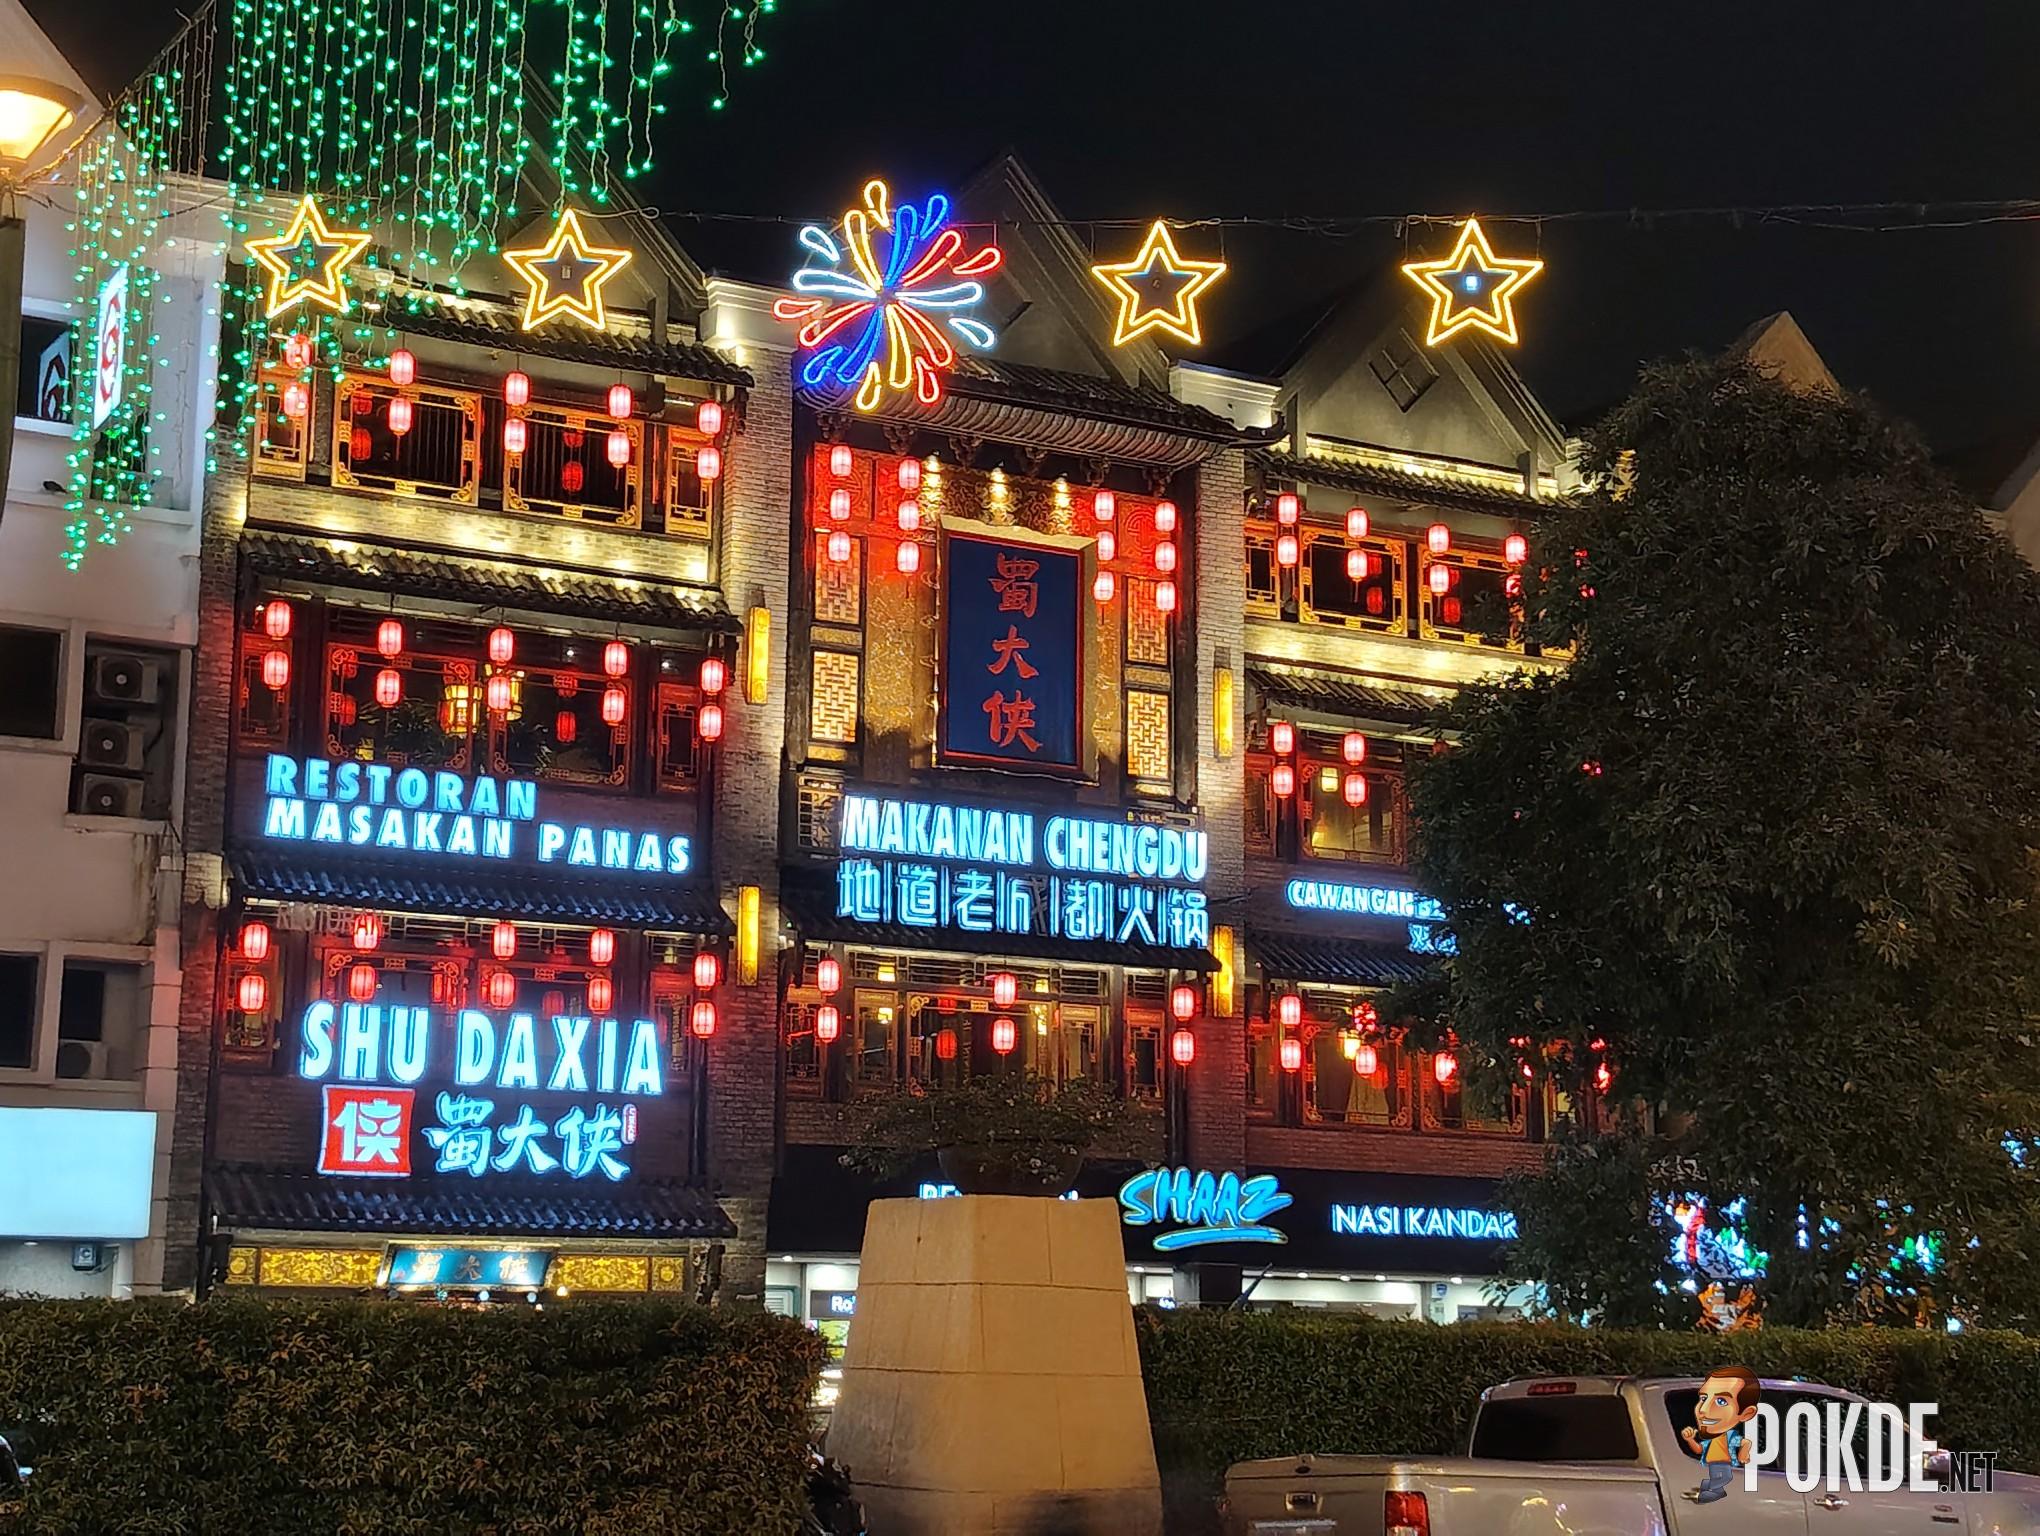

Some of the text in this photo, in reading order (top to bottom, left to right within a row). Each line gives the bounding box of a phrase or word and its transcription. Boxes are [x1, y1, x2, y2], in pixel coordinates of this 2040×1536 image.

[982, 552, 1043, 752] 蜀大侠
[266, 753, 538, 820] RESTORAN
[264, 797, 691, 874] MASAKAN PANAS
[840, 795, 1208, 882] MAKANAN CHENGDU
[1286, 879, 1414, 918] CAWANGAN
[300, 999, 663, 1096] SHU DAXIA
[422, 1090, 633, 1182] 蜀大侠
[1119, 1165, 1294, 1226] SHAAZ
[1331, 1203, 1519, 1239] NASI KANDAR
